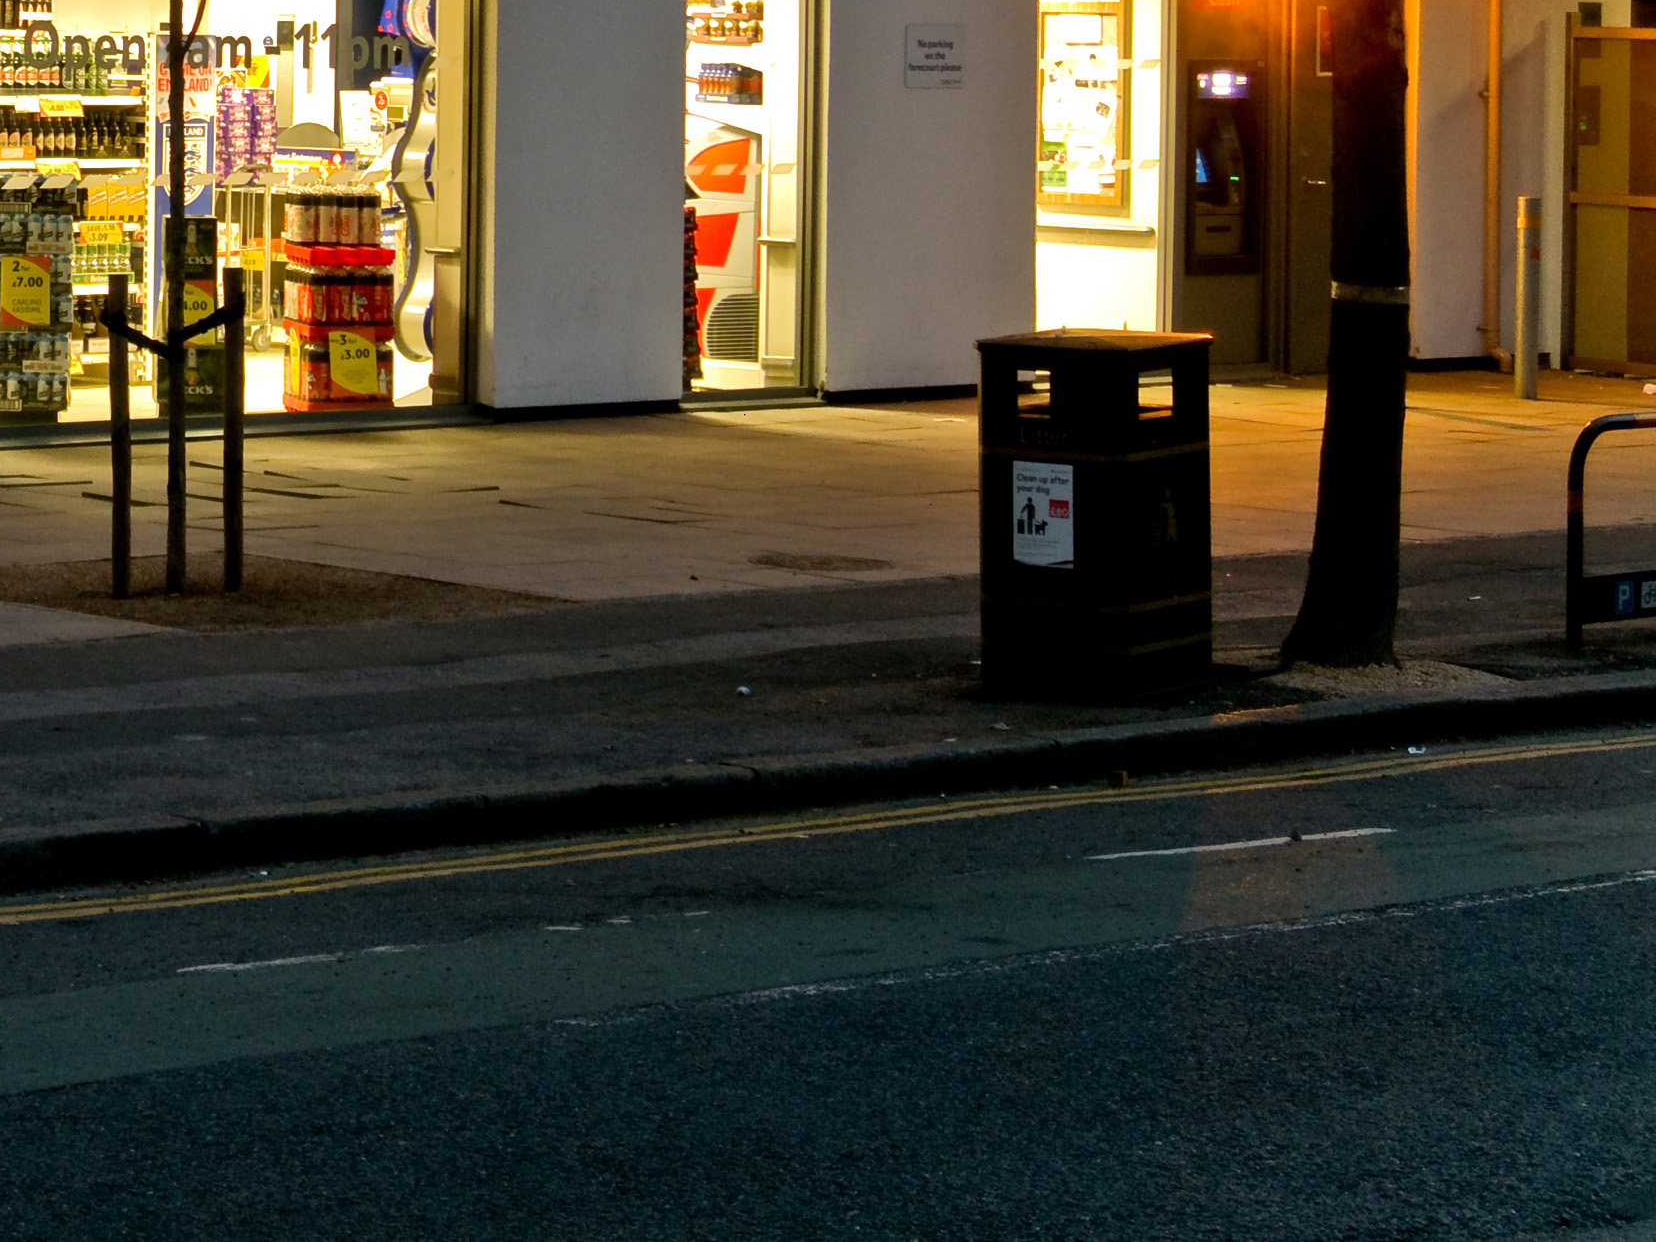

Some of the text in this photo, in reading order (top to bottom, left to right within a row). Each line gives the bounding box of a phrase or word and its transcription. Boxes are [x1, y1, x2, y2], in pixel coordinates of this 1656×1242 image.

[24, 19, 147, 83] Open
[161, 22, 252, 70] am
[294, 22, 412, 83] 11pm
[159, 62, 196, 76] CME
[157, 77, 213, 93] ENLAND!
[11, 260, 21, 272] 2
[12, 276, 44, 288] £7.00
[339, 334, 347, 346] 3
[1016, 473, 1070, 486] Clean up after
[1016, 485, 1050, 496] your dog
[1618, 584, 1630, 611] P
